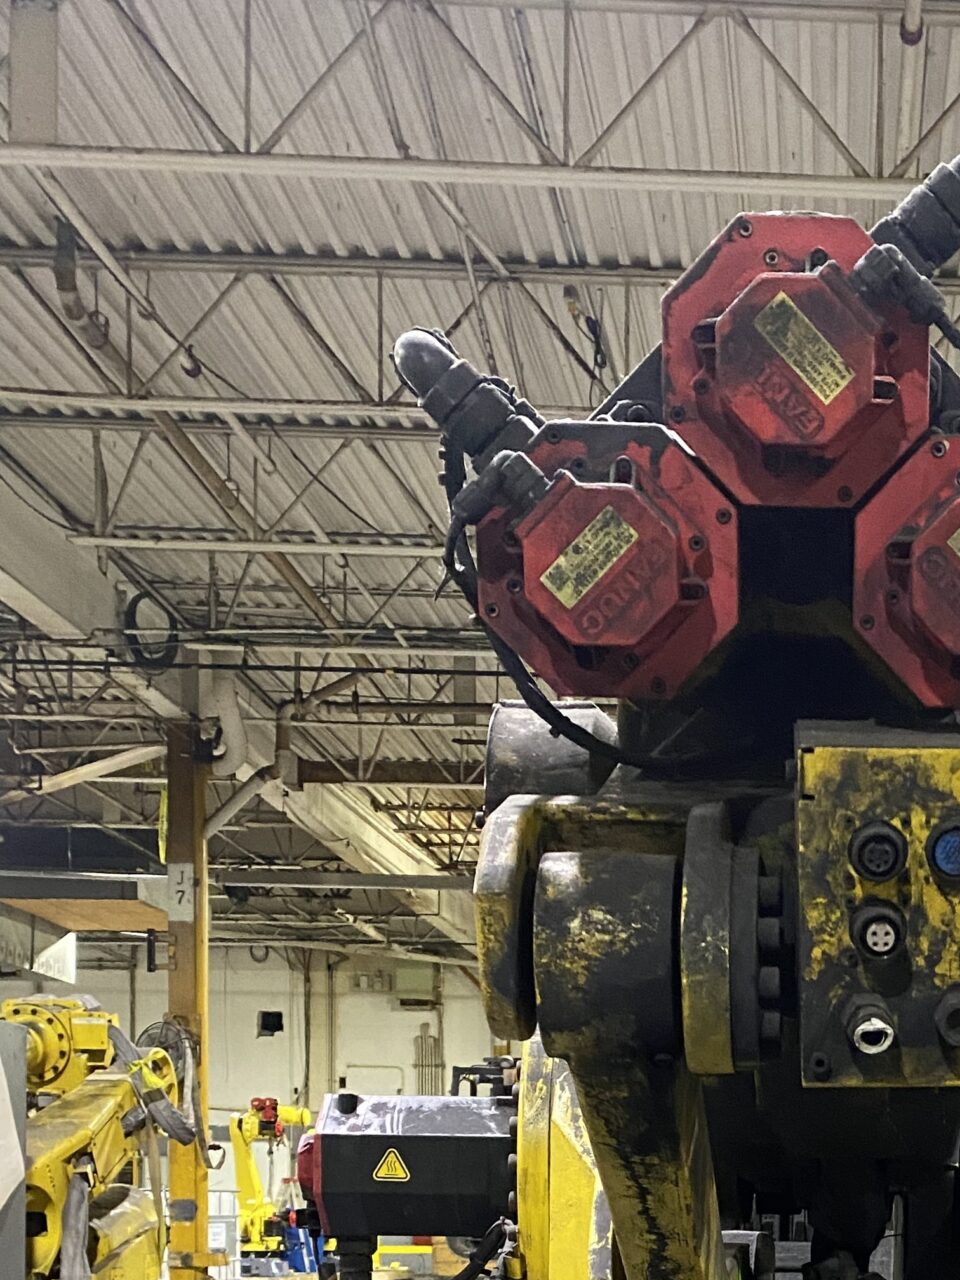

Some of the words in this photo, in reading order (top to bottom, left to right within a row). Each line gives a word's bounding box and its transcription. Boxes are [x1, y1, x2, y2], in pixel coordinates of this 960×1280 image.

[577, 542, 668, 638] FANUC
[176, 871, 184, 885] J
[176, 890, 185, 905] 7
